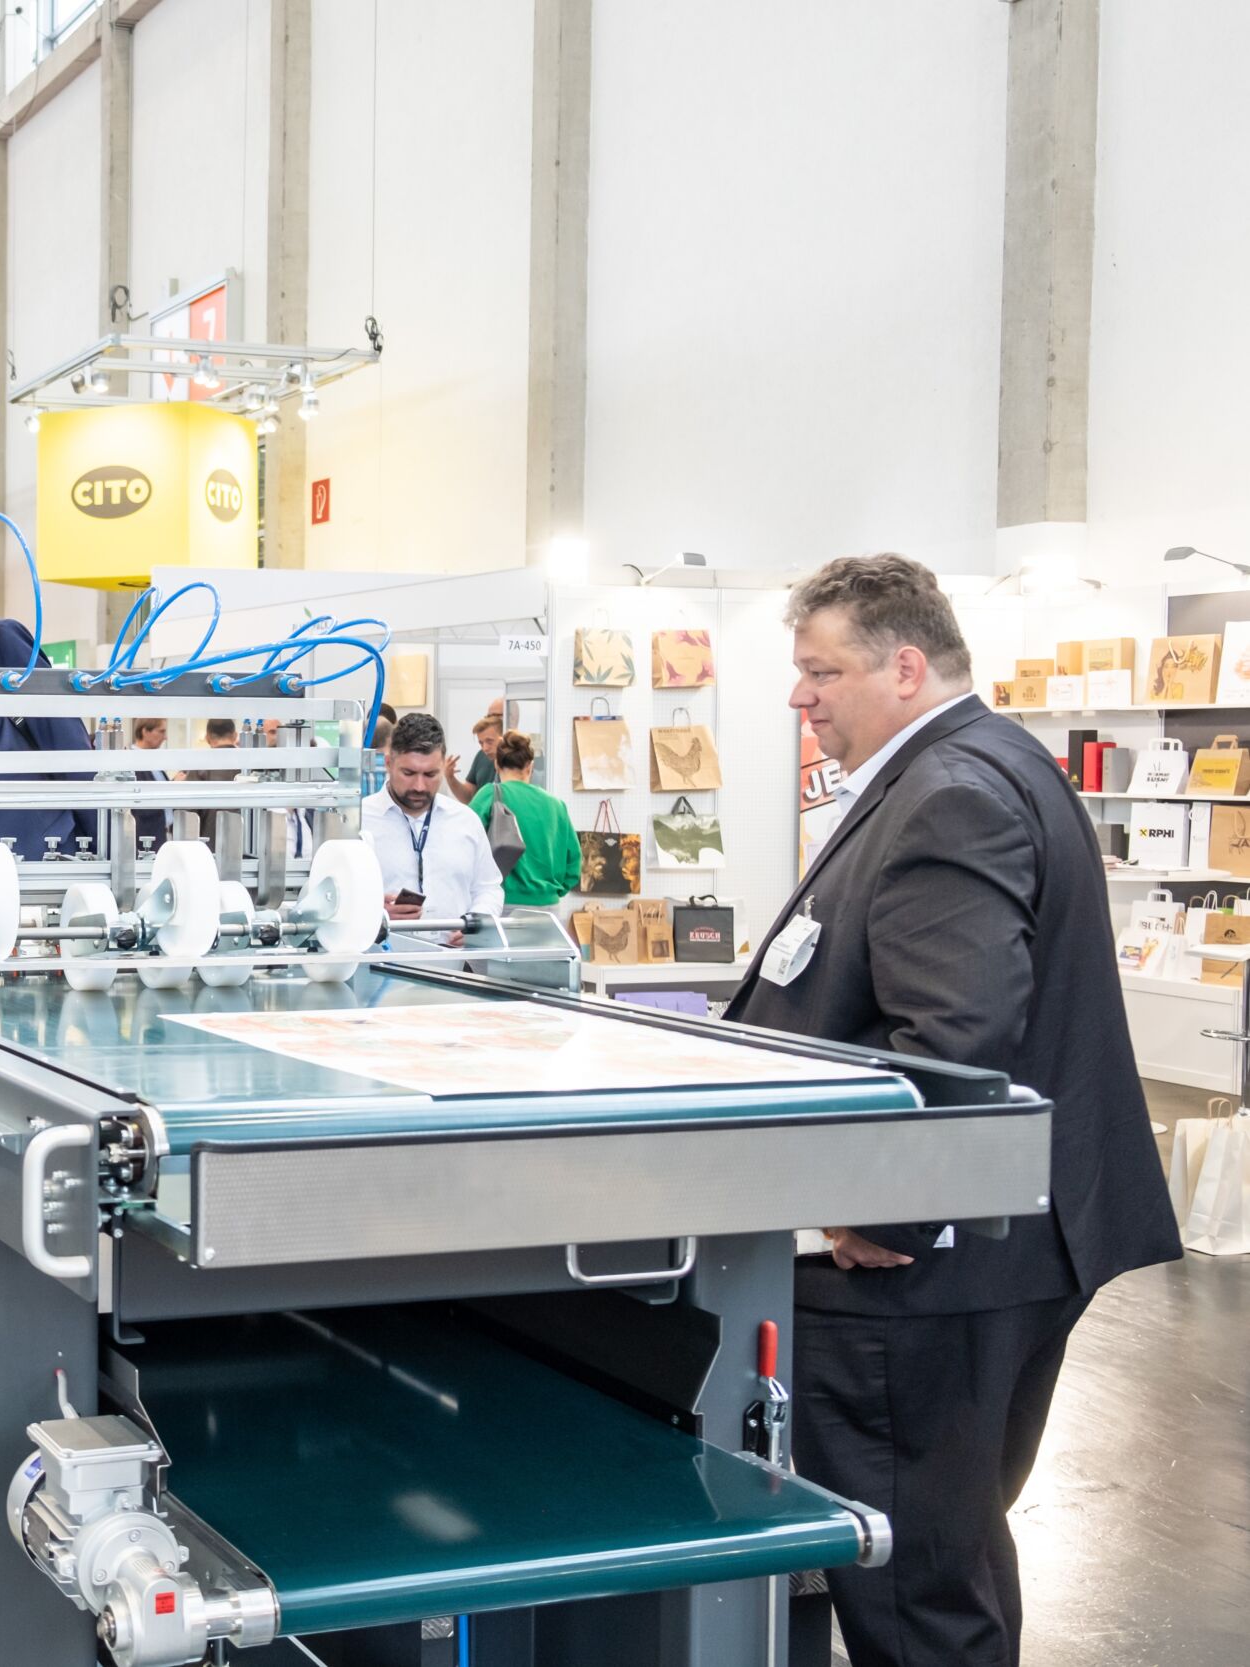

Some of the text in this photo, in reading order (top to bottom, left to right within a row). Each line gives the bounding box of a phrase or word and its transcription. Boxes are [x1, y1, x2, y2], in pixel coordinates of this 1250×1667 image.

[73, 478, 151, 507] CITO
[207, 480, 242, 511] CITO
[508, 640, 542, 651] 7A-450
